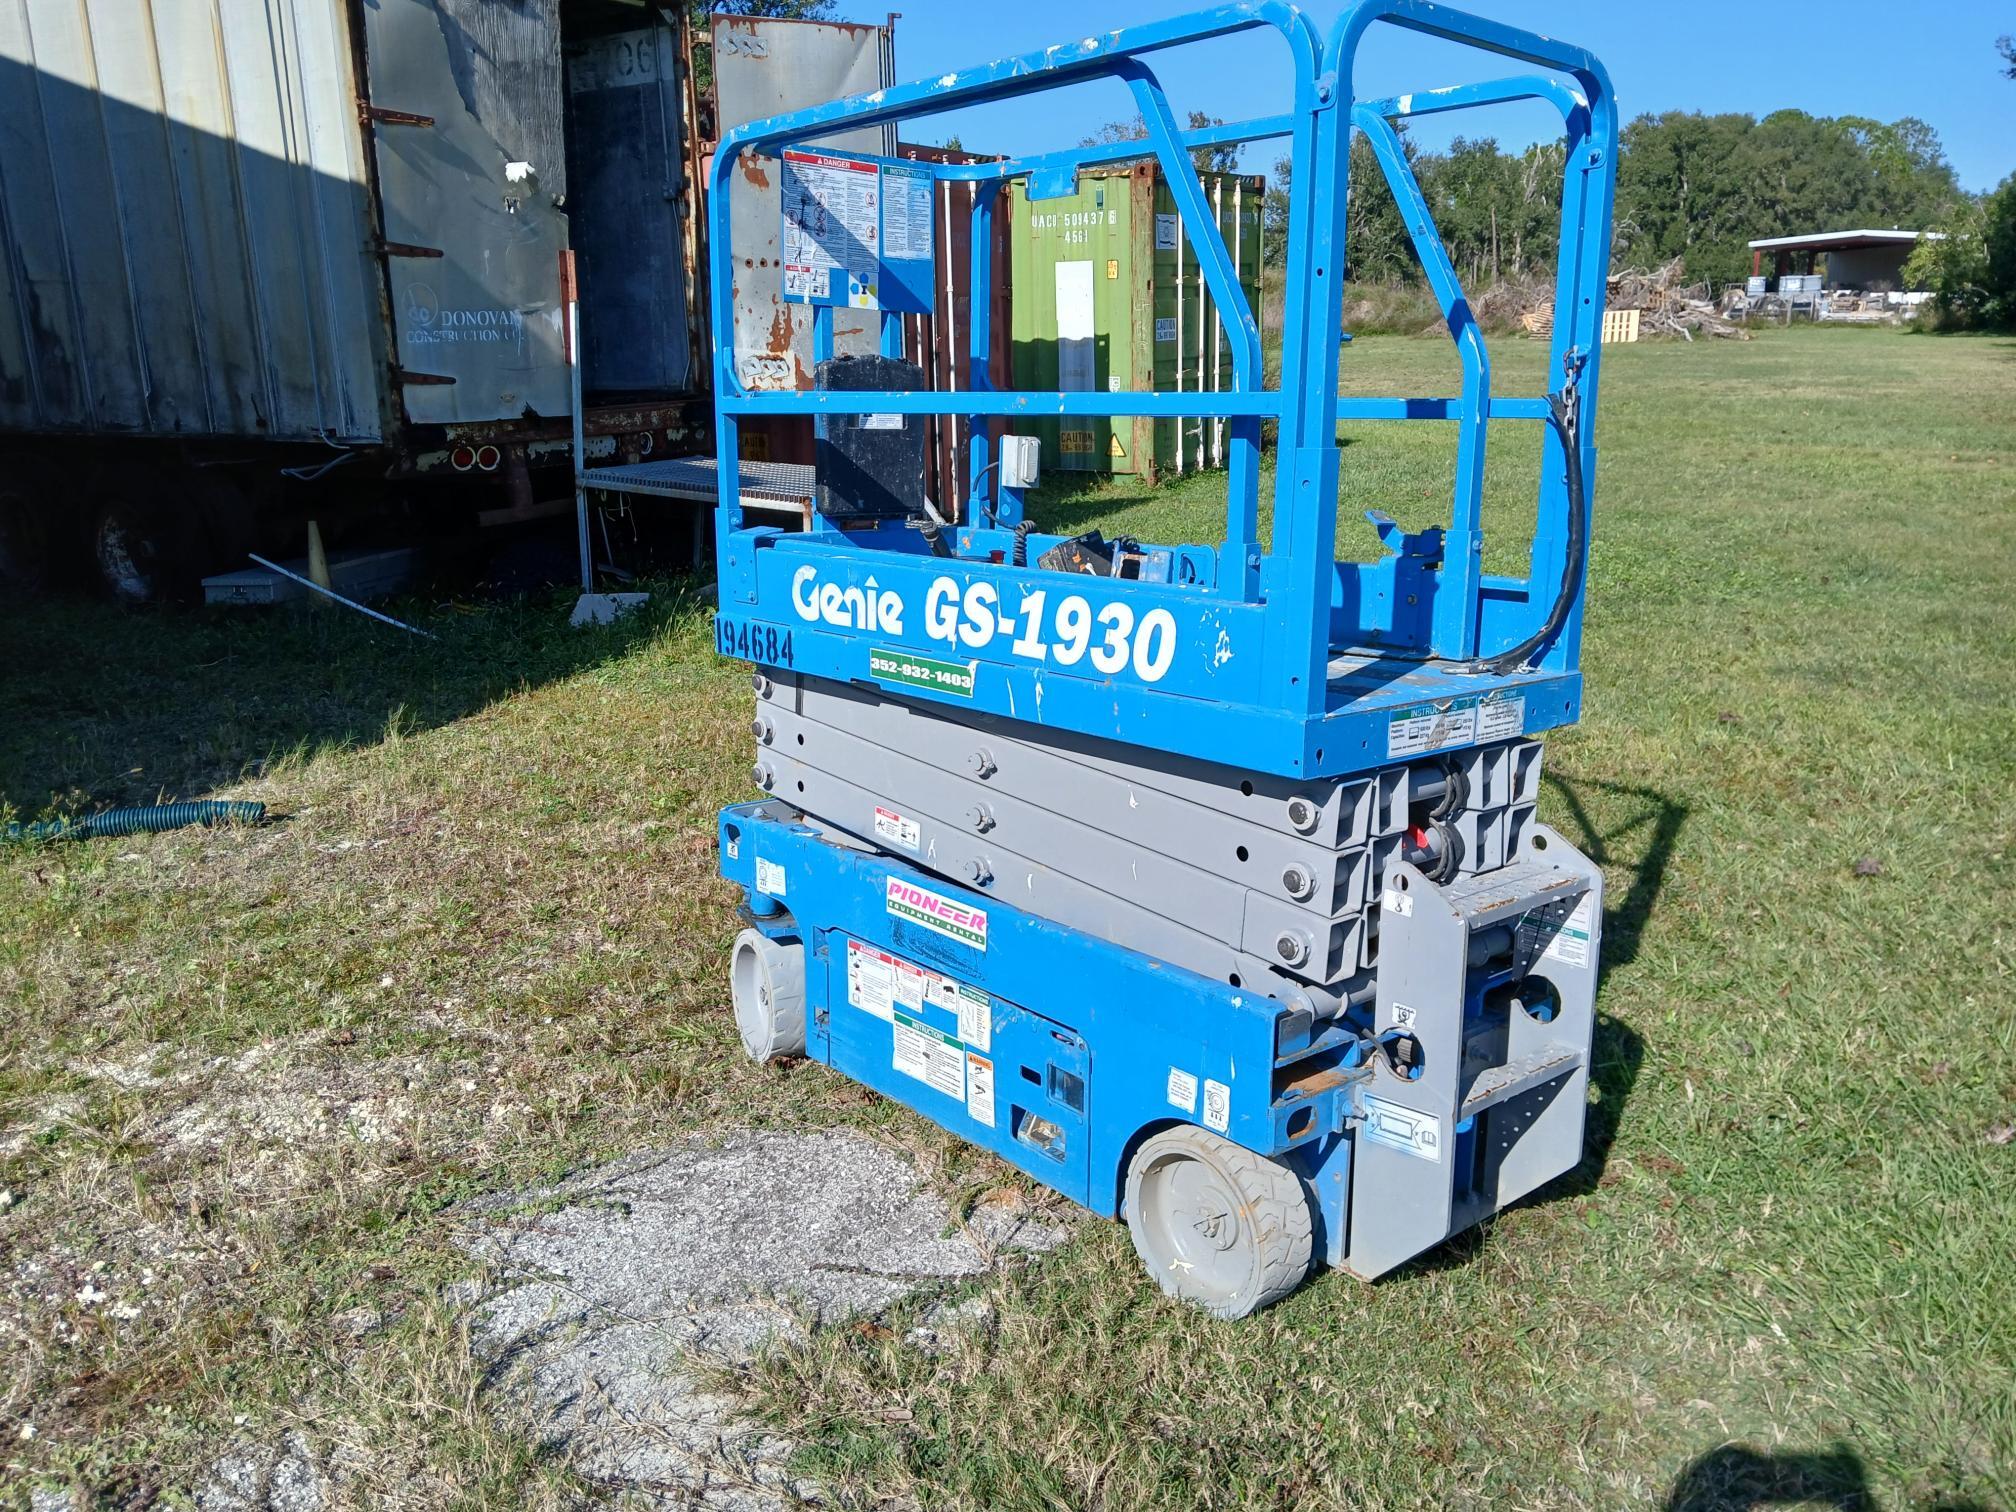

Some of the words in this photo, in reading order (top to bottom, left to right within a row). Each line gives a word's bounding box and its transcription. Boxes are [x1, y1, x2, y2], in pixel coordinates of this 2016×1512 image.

[823, 160, 851, 169] DANGER
[889, 168, 926, 179] INSTRUCTIONS
[441, 310, 523, 327] DONOVAN
[406, 329, 500, 344] CONSTRUCTION
[1061, 432, 1093, 443] CAUTION
[791, 565, 903, 636] Genie
[924, 576, 1178, 683] GS-1930
[716, 617, 794, 668] 194684
[870, 657, 972, 689] 352-932-1403
[888, 882, 986, 931] PIONEER
[888, 901, 941, 926] EQUIPMENT
[945, 923, 984, 943] RENTAL
[911, 1021, 945, 1042] INSTRUCTIONS
